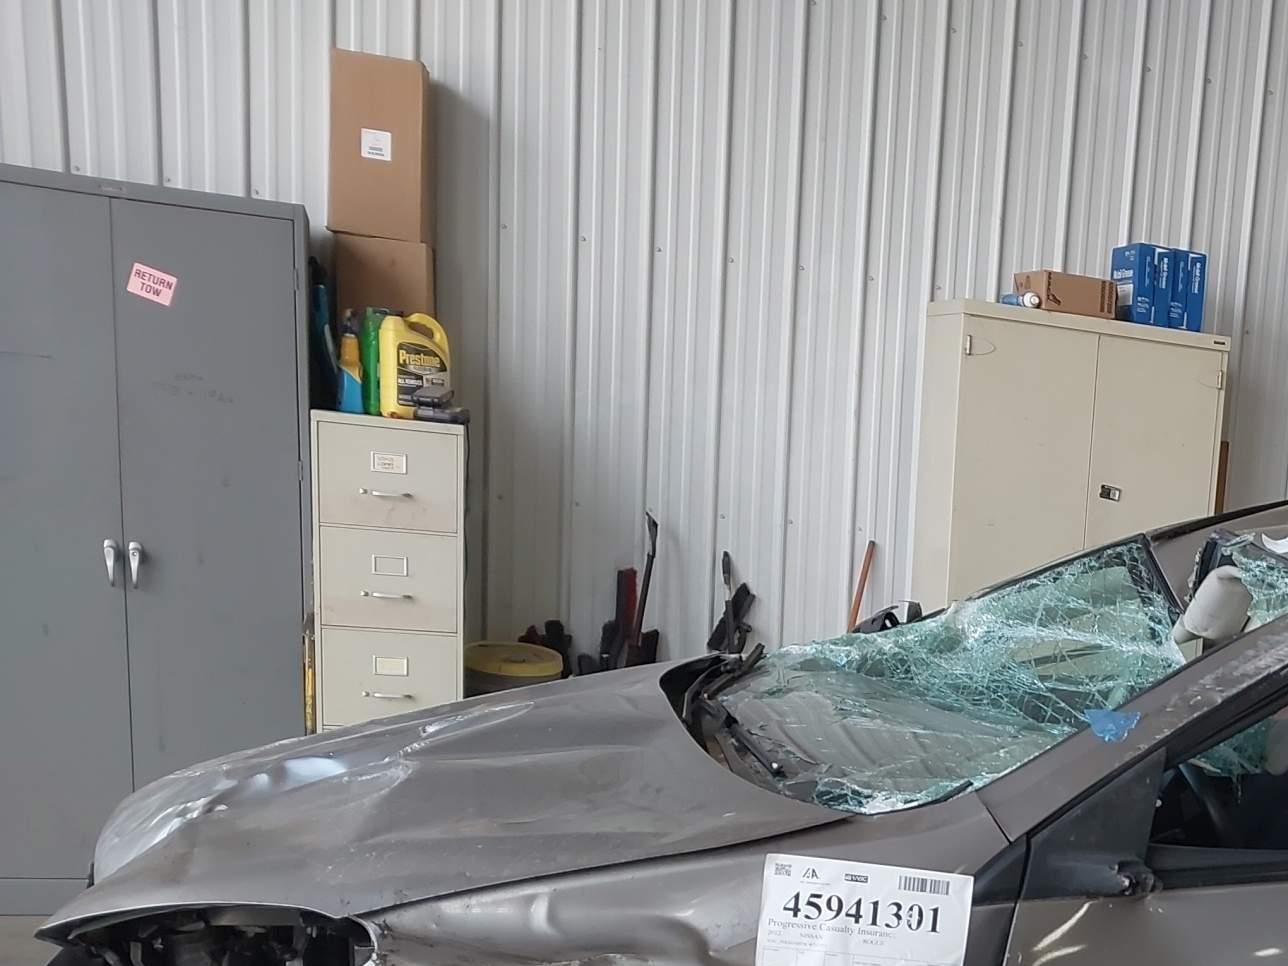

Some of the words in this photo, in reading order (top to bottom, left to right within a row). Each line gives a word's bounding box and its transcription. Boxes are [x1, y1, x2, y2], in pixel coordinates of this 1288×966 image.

[134, 269, 174, 290] RETURN
[140, 281, 162, 297] TOW
[783, 891, 940, 934] 45941301
[768, 918, 817, 931] Progressive
[819, 924, 854, 936] Casualty
